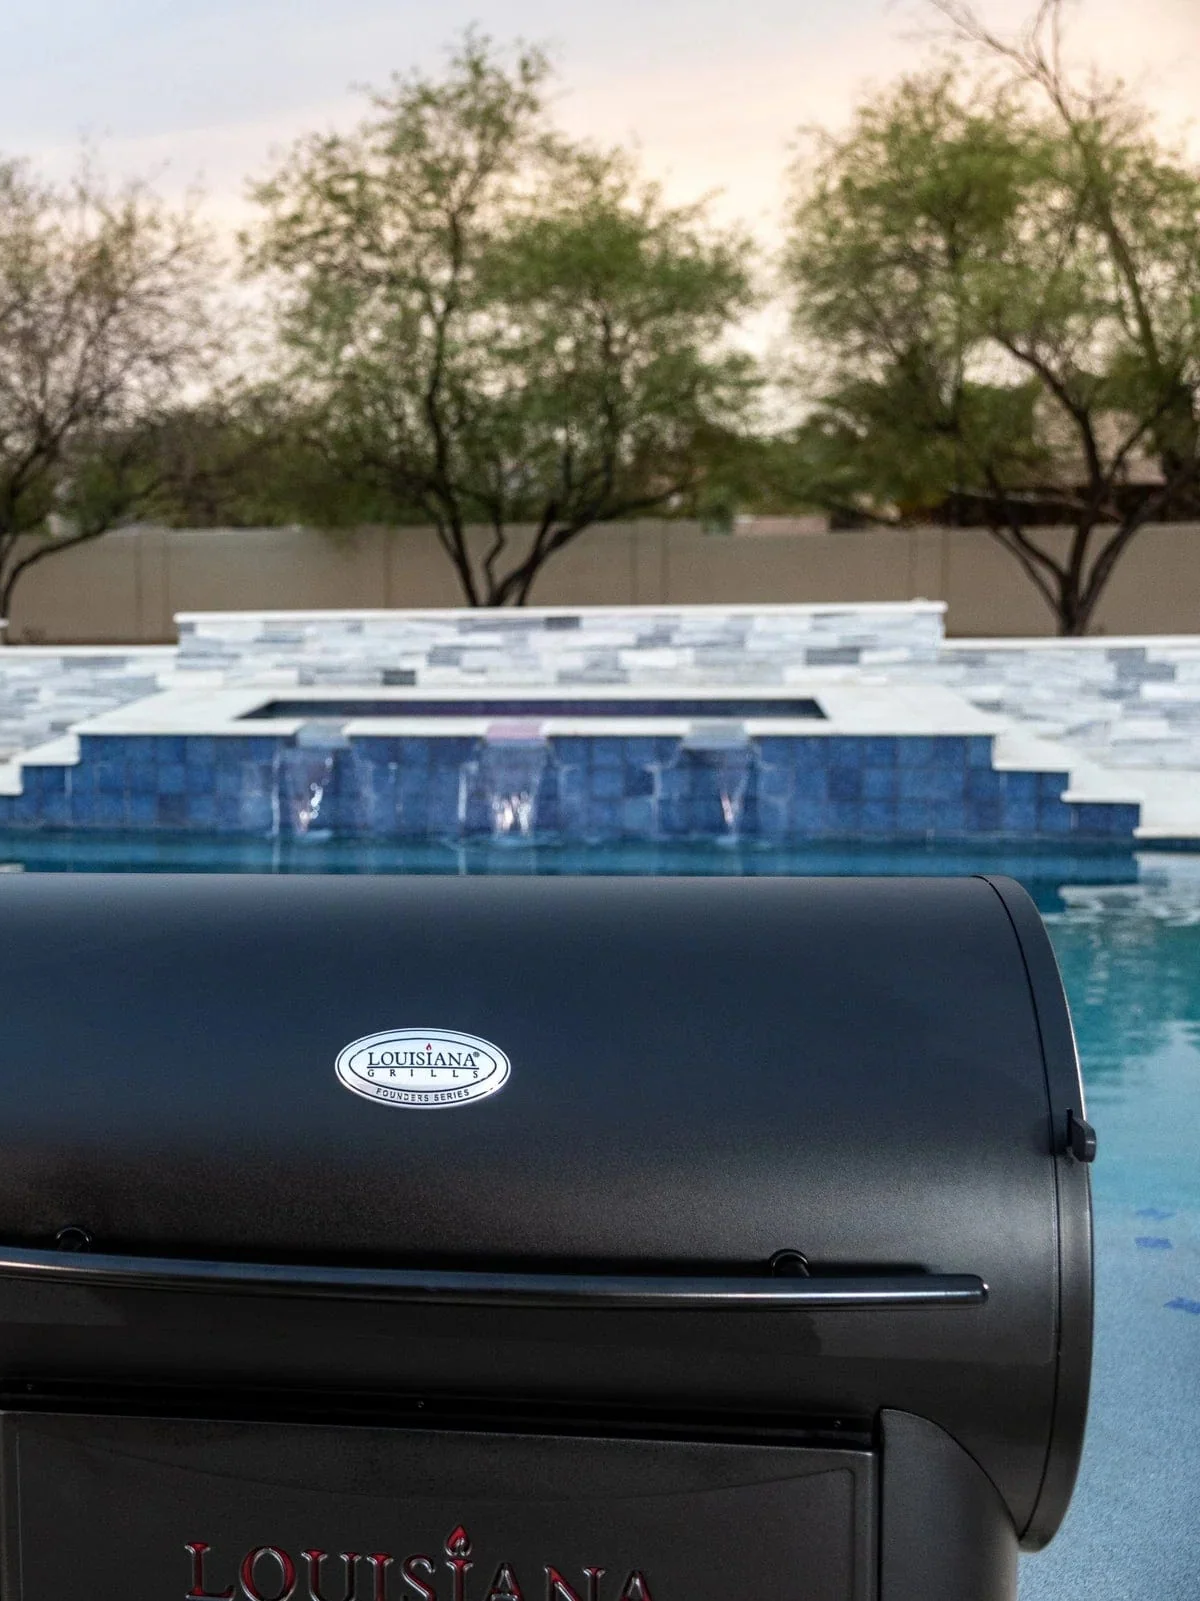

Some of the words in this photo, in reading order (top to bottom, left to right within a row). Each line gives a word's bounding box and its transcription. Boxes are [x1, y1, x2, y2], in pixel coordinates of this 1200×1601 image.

[367, 1069, 479, 1078] GRILLS
[376, 1088, 429, 1102] FOUNDERS
[434, 1089, 470, 1102] SERIES
[185, 1541, 653, 1601] LOUISIANA
